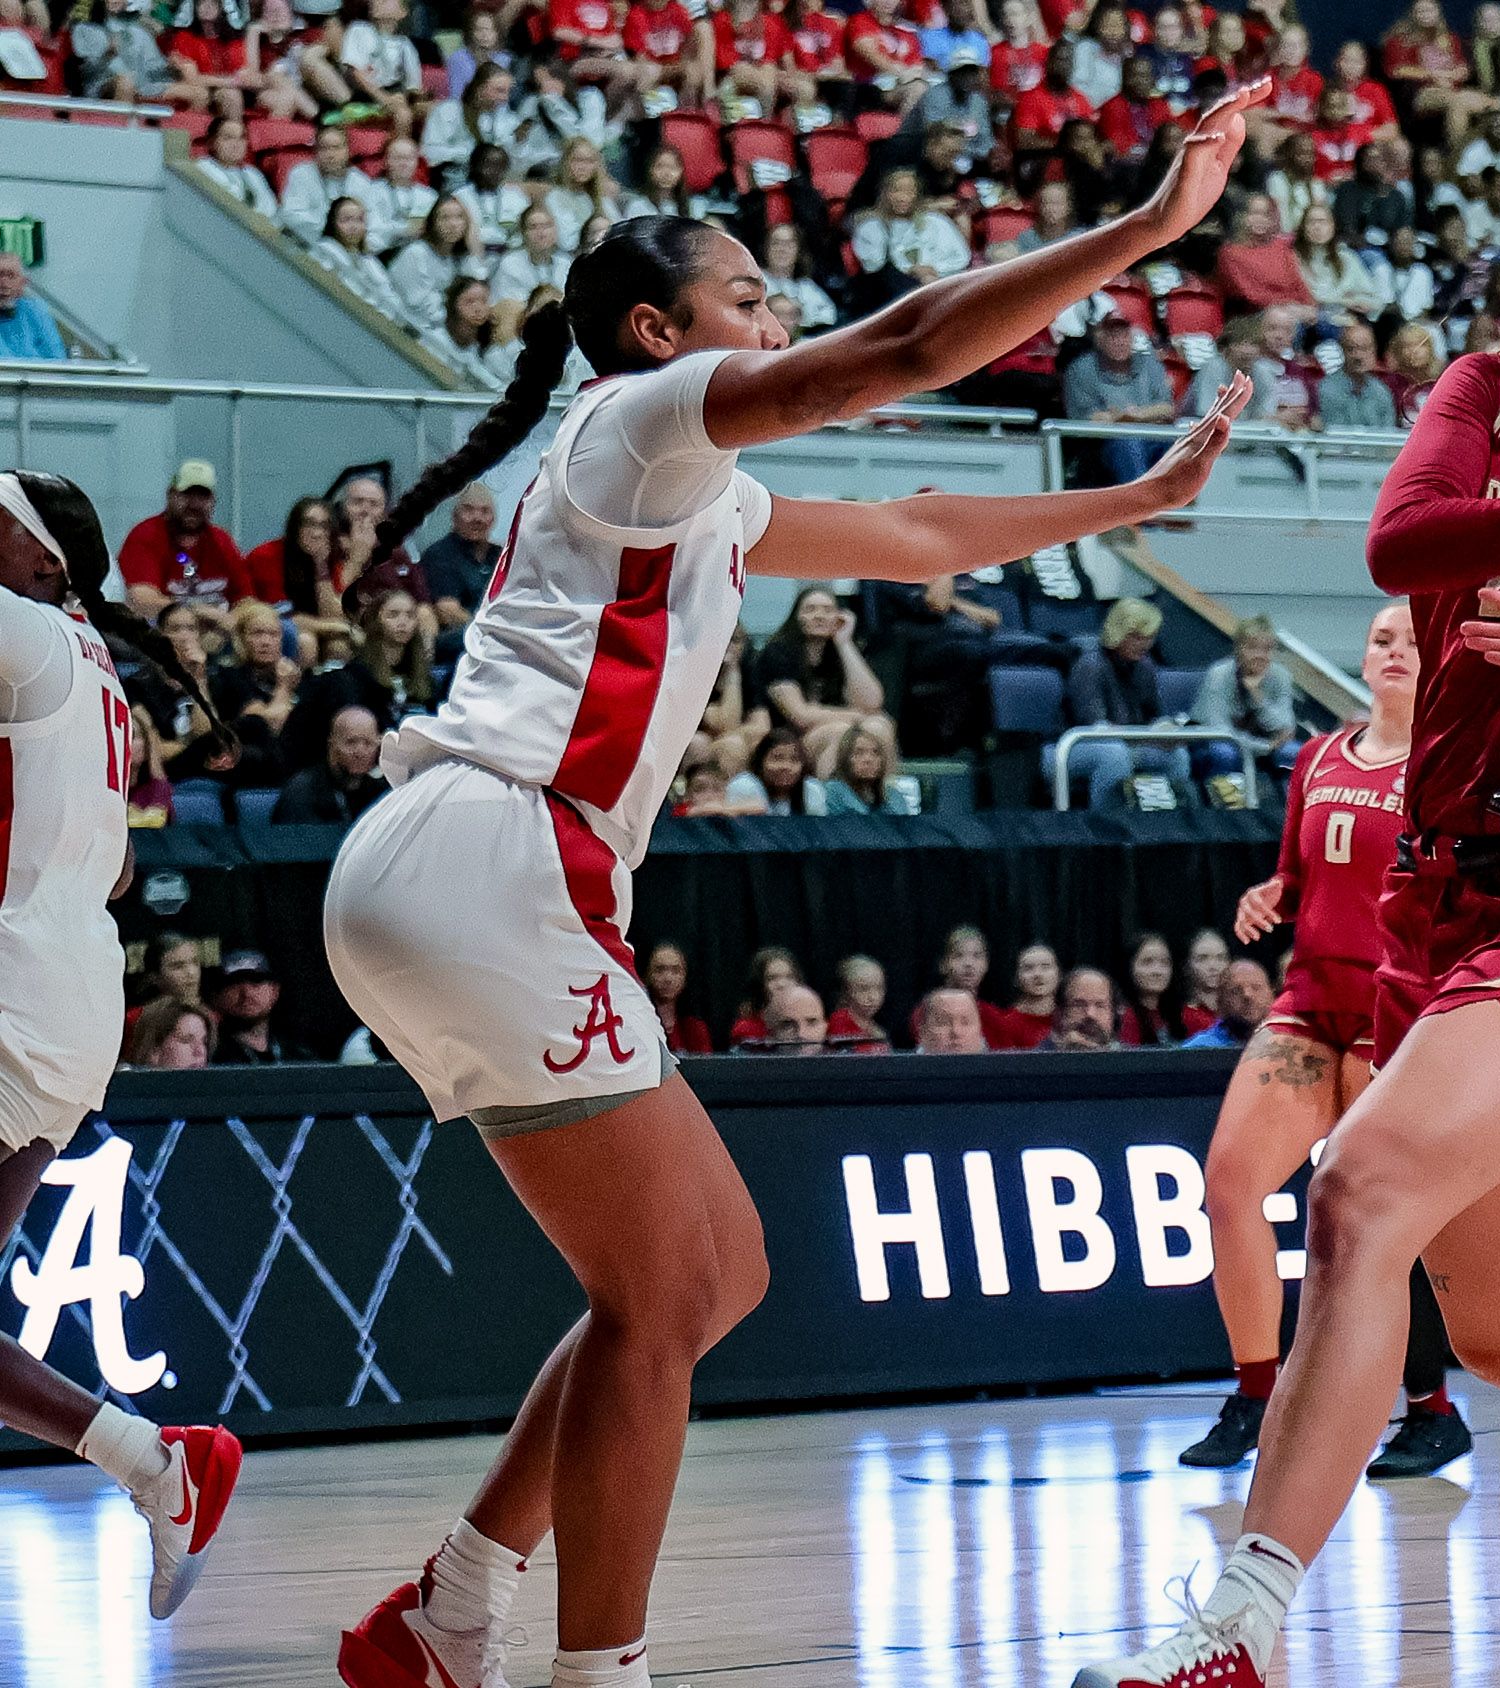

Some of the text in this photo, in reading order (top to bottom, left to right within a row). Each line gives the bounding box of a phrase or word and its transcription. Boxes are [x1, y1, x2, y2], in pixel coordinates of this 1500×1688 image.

[1325, 811, 1356, 863] 0
[543, 973, 636, 1075] A
[10, 1136, 167, 1394] A
